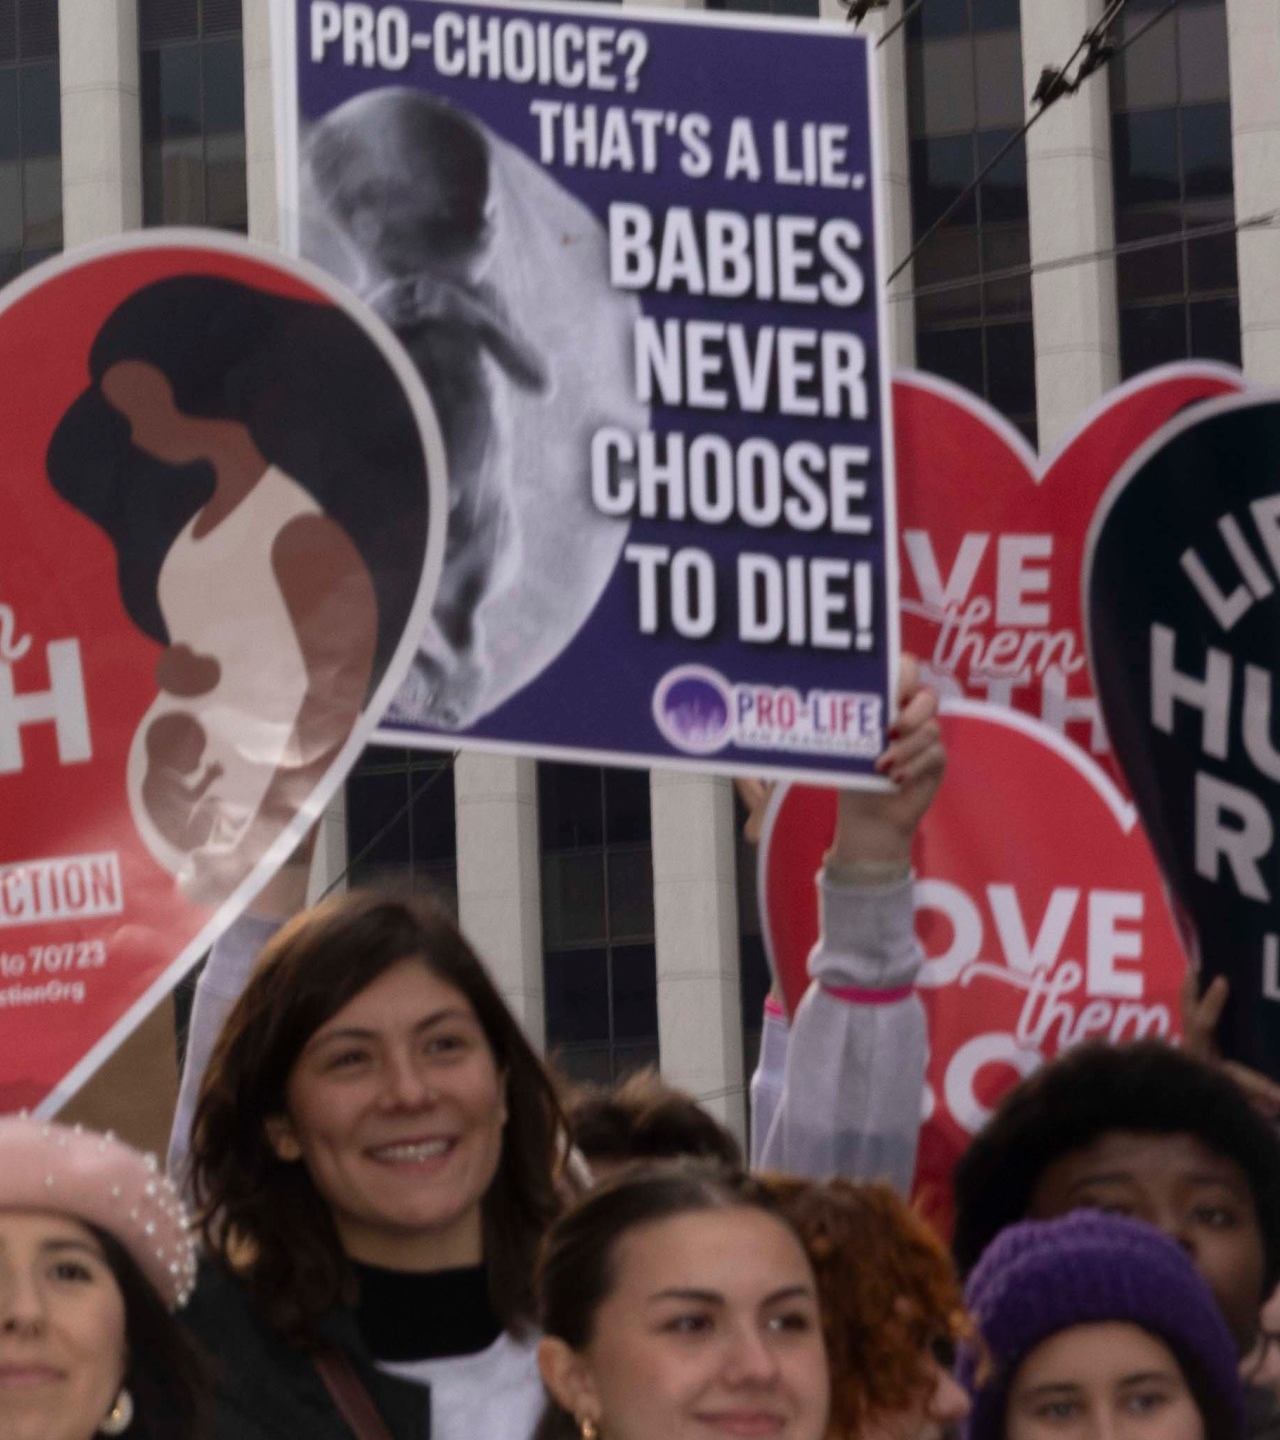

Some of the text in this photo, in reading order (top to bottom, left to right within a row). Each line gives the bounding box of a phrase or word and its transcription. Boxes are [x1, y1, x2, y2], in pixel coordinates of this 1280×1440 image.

[530, 100, 866, 189] THAT'S A LIE.
[608, 202, 865, 307] BABIES
[639, 317, 868, 419] NEVER
[591, 425, 873, 534] CHOOSE
[625, 544, 874, 651] TO DIE!
[903, 529, 1053, 628] VE
[900, 595, 1086, 674] them
[737, 691, 874, 735] PRO-LIFE
[0, 951, 26, 977] to
[29, 939, 107, 973] 70723
[914, 878, 1144, 998] OVE
